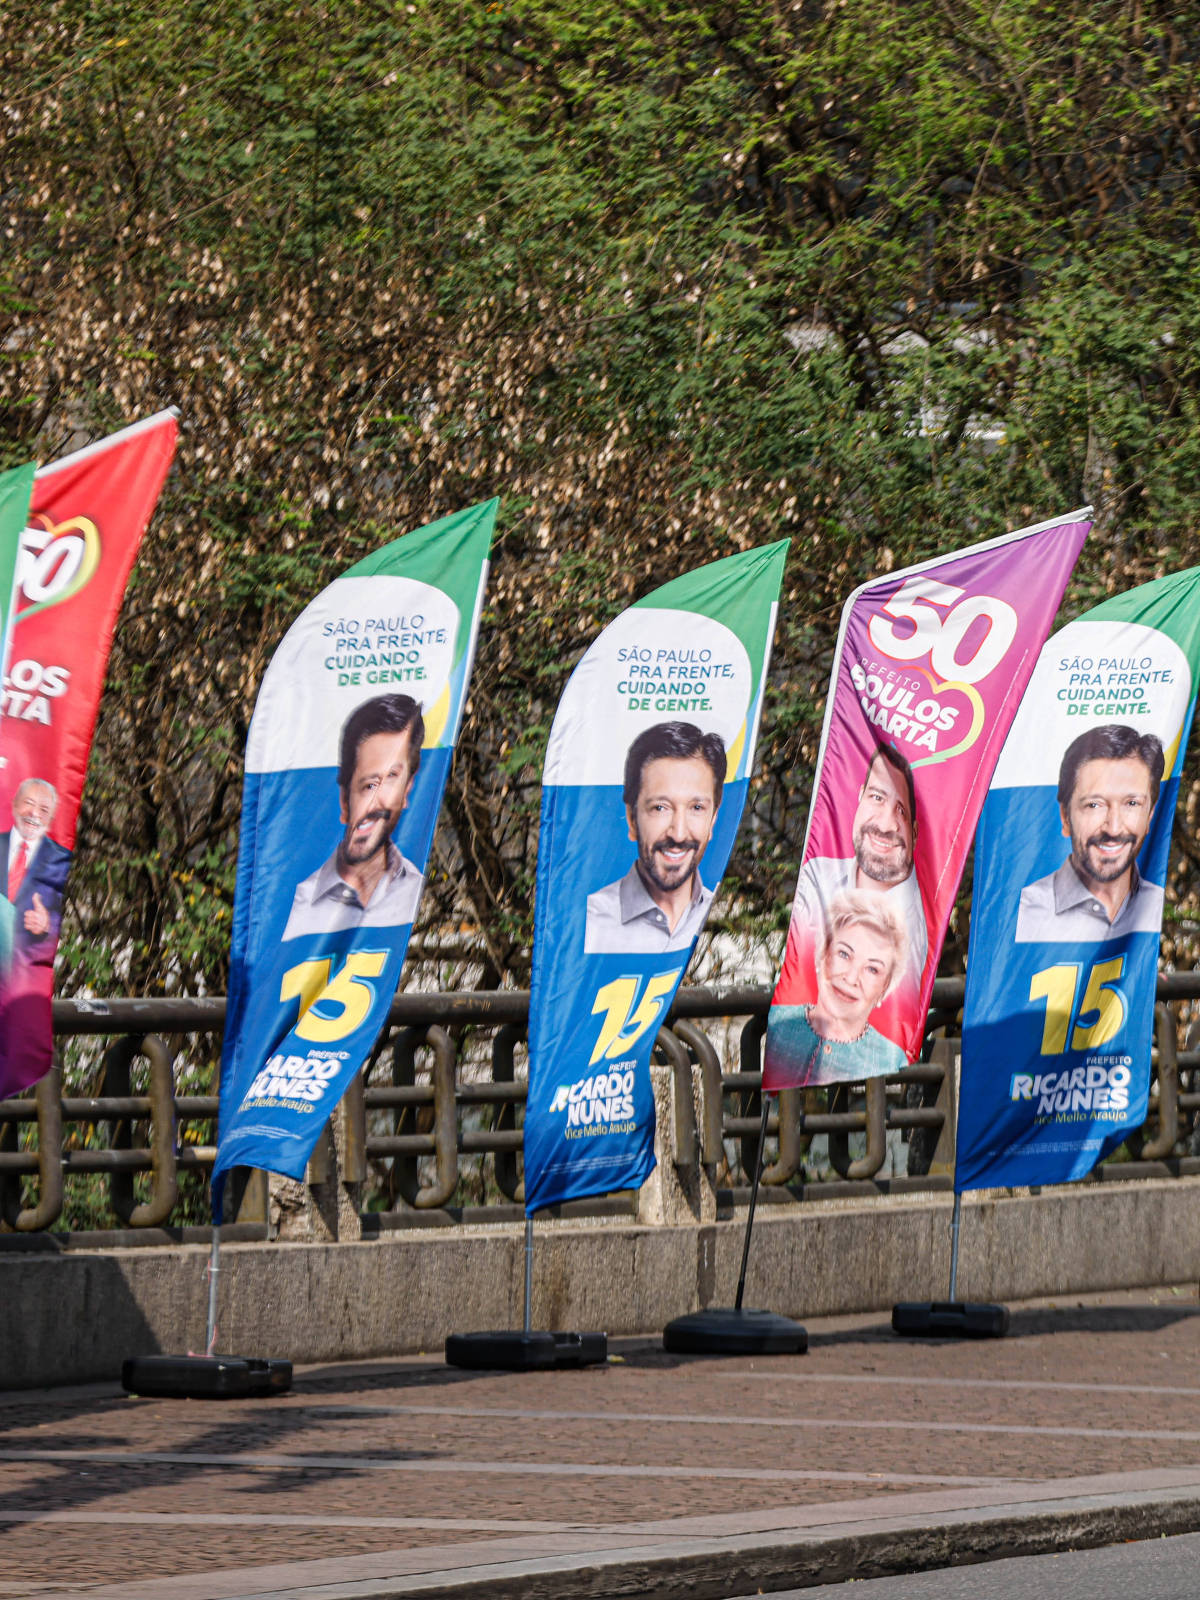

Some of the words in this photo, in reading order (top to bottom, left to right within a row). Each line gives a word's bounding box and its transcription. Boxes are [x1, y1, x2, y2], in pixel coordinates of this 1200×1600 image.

[322, 618, 360, 637] SÃO
[364, 614, 424, 633] PAULO
[866, 575, 1019, 685] 50
[336, 636, 371, 652] PRA
[376, 628, 448, 649] FRENTE,
[324, 650, 420, 670] CUIDANDO
[617, 645, 652, 662] SÃO
[656, 649, 712, 663] PAULO
[1058, 656, 1094, 671] SÃO
[1097, 657, 1152, 671] PAULO
[337, 672, 362, 687] DE
[366, 666, 428, 684] GENTE.
[628, 665, 663, 679] PRA
[667, 663, 736, 679] FRENTE,
[1069, 673, 1102, 686] PRA
[1107, 669, 1175, 686] FRENTE,
[616, 681, 706, 695] CUIDANDO
[1056, 687, 1145, 701] CUIDANDO
[627, 698, 650, 711] DE
[655, 698, 713, 711] GENTE.
[1066, 704, 1090, 716] DE
[1093, 702, 1151, 716] GENTE.
[279, 948, 391, 1043] 15
[1028, 952, 1129, 1056] 15
[588, 967, 683, 1067] 15
[1086, 1055, 1133, 1066] PREFEITO
[1009, 1064, 1132, 1101] RICARDO
[566, 1094, 635, 1127] NUNES
[1036, 1087, 1130, 1115] NUNES
[1055, 1112, 1088, 1124] Mello
[1089, 1109, 1128, 1123] Araújo
[564, 1124, 583, 1140] Vice
